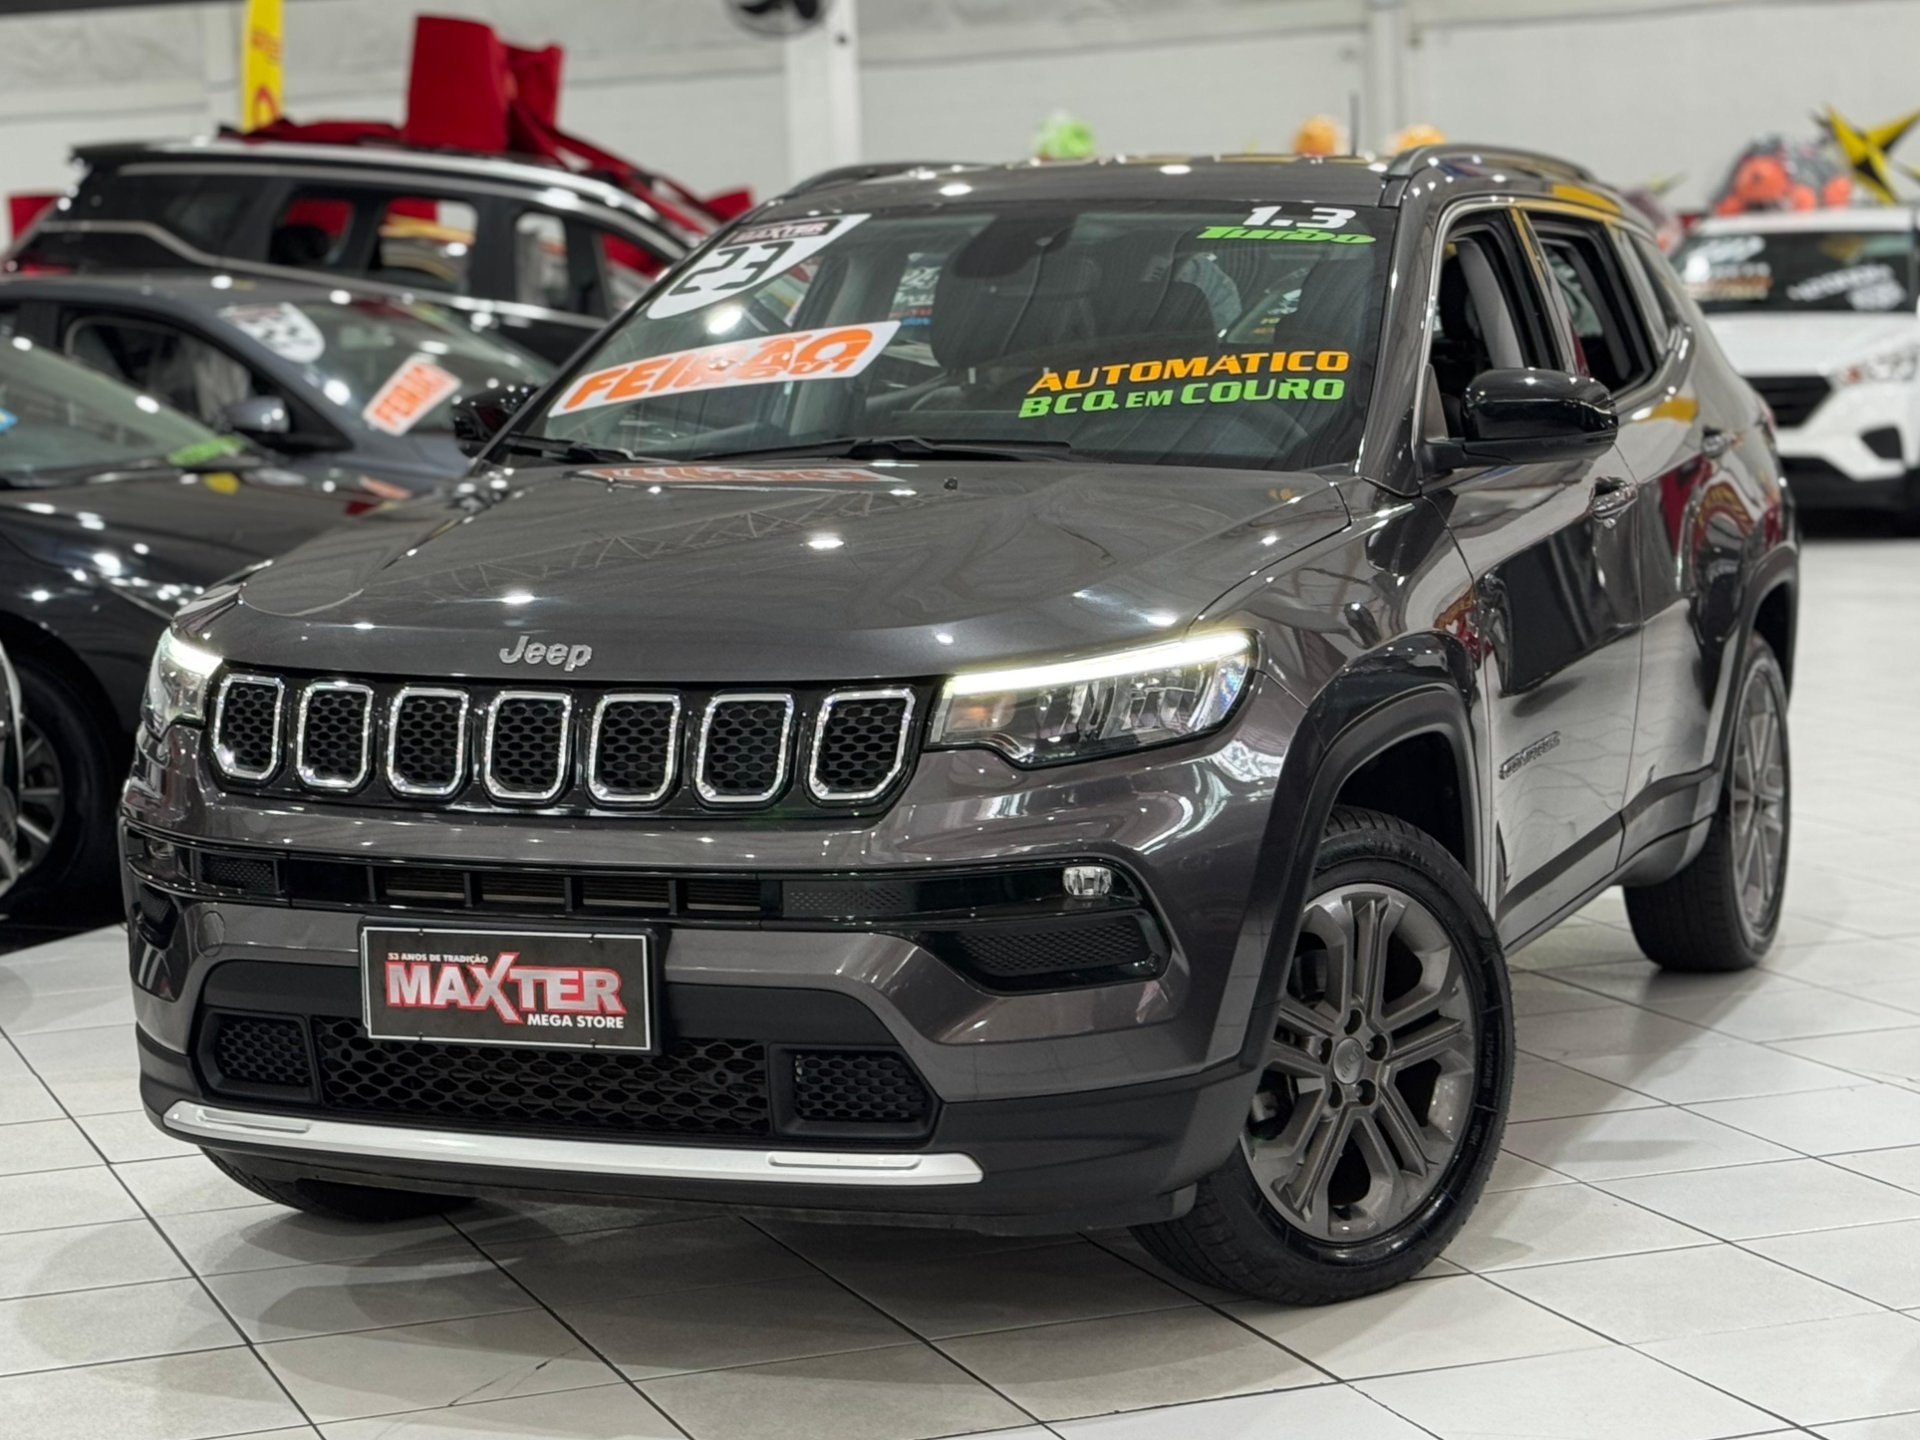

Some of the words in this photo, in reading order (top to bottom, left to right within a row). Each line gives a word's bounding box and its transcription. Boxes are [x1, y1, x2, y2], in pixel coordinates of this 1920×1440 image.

[1243, 206, 1356, 229] 1.3
[668, 241, 794, 296] 23
[1126, 390, 1174, 408] EM
[1180, 379, 1345, 404] COURO
[499, 635, 592, 672] Jeep
[401, 953, 427, 961] ANOS
[429, 954, 441, 962] DE
[443, 954, 489, 965] TRADIÇÃO
[385, 952, 627, 1025] MAXTER
[527, 1013, 573, 1027] MEGA
[577, 1015, 624, 1029] STORE
